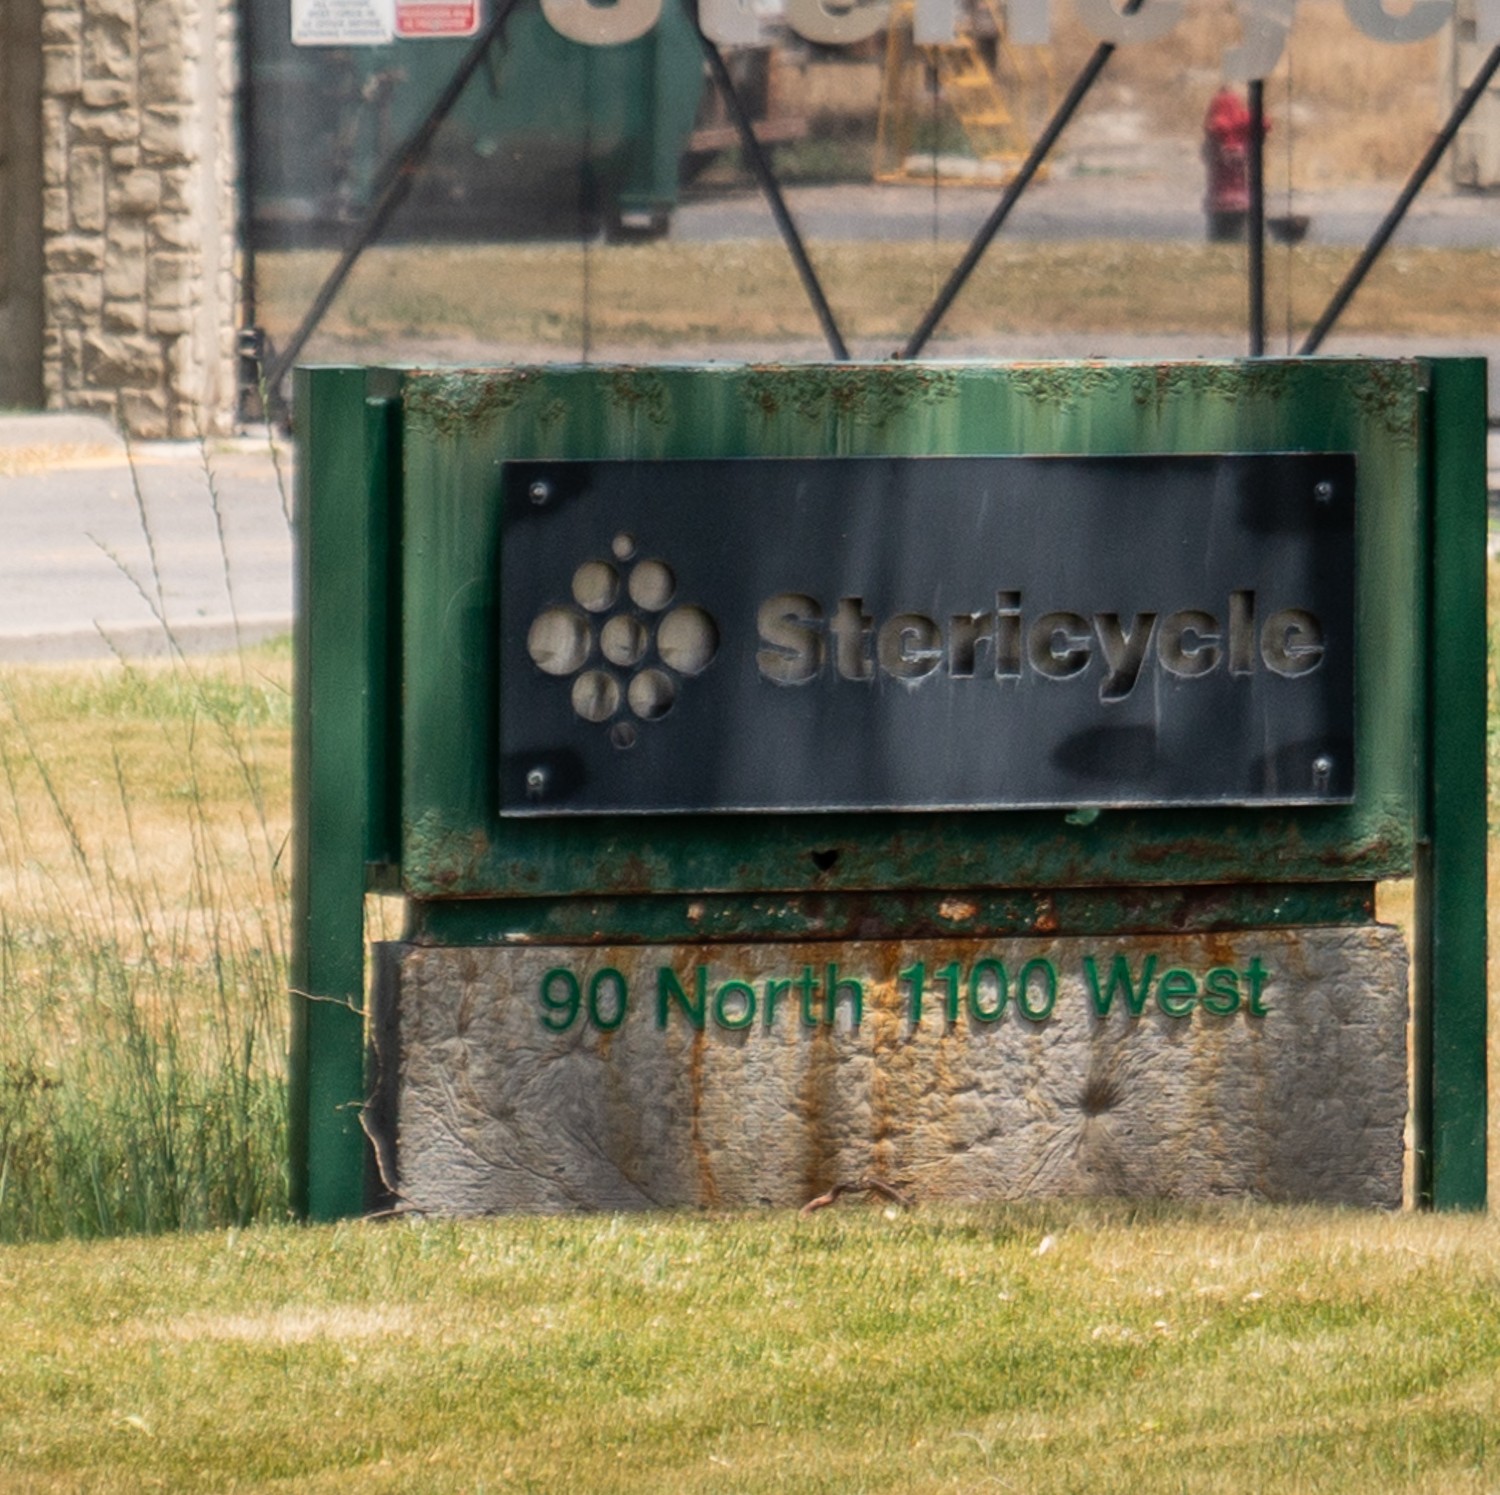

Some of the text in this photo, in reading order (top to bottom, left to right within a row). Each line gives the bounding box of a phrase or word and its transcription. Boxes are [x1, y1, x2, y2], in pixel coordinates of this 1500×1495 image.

[756, 589, 1327, 703] Stericycle
[537, 954, 1270, 1033] 90 North 1100 West
